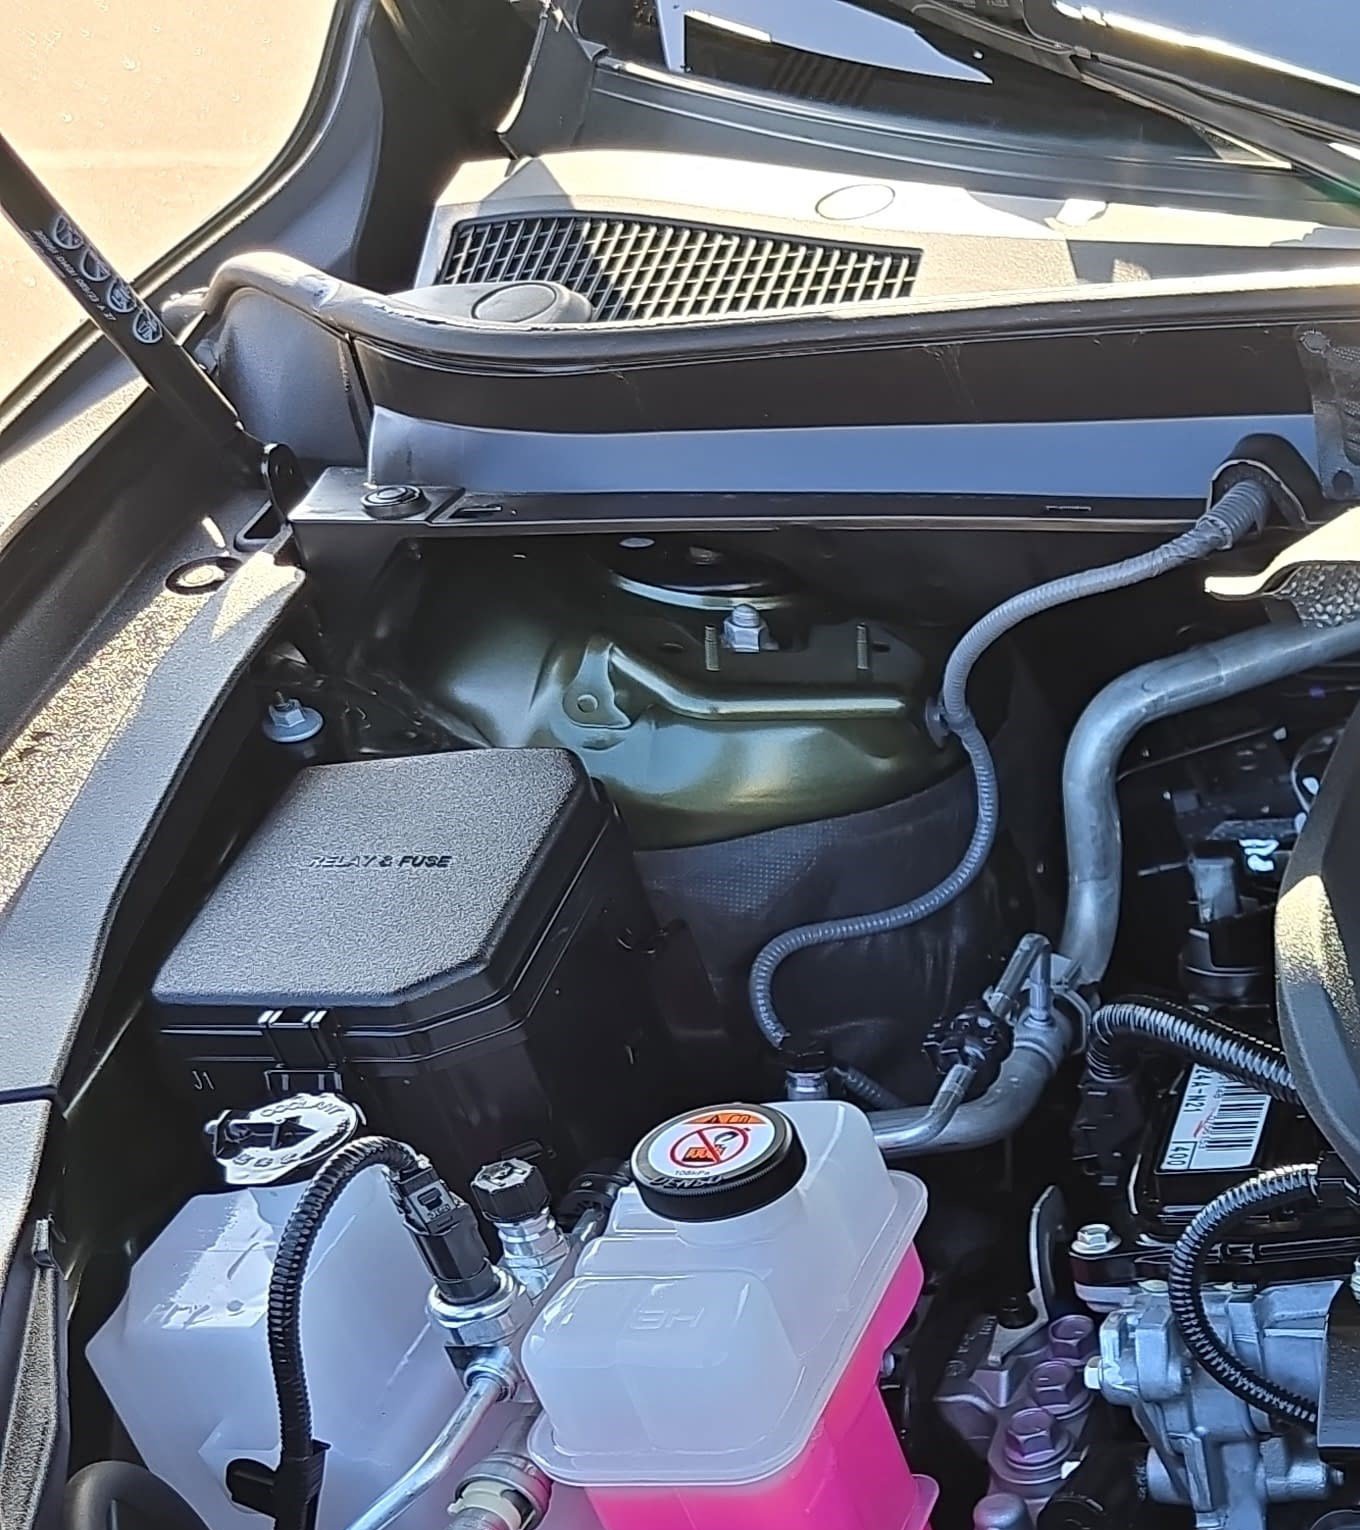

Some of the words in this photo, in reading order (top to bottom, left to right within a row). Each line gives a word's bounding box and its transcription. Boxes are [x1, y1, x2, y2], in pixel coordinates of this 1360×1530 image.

[308, 855, 377, 868] RELAY
[379, 855, 393, 867] &
[399, 855, 452, 868] FUSE
[1166, 1146, 1190, 1166] 400
